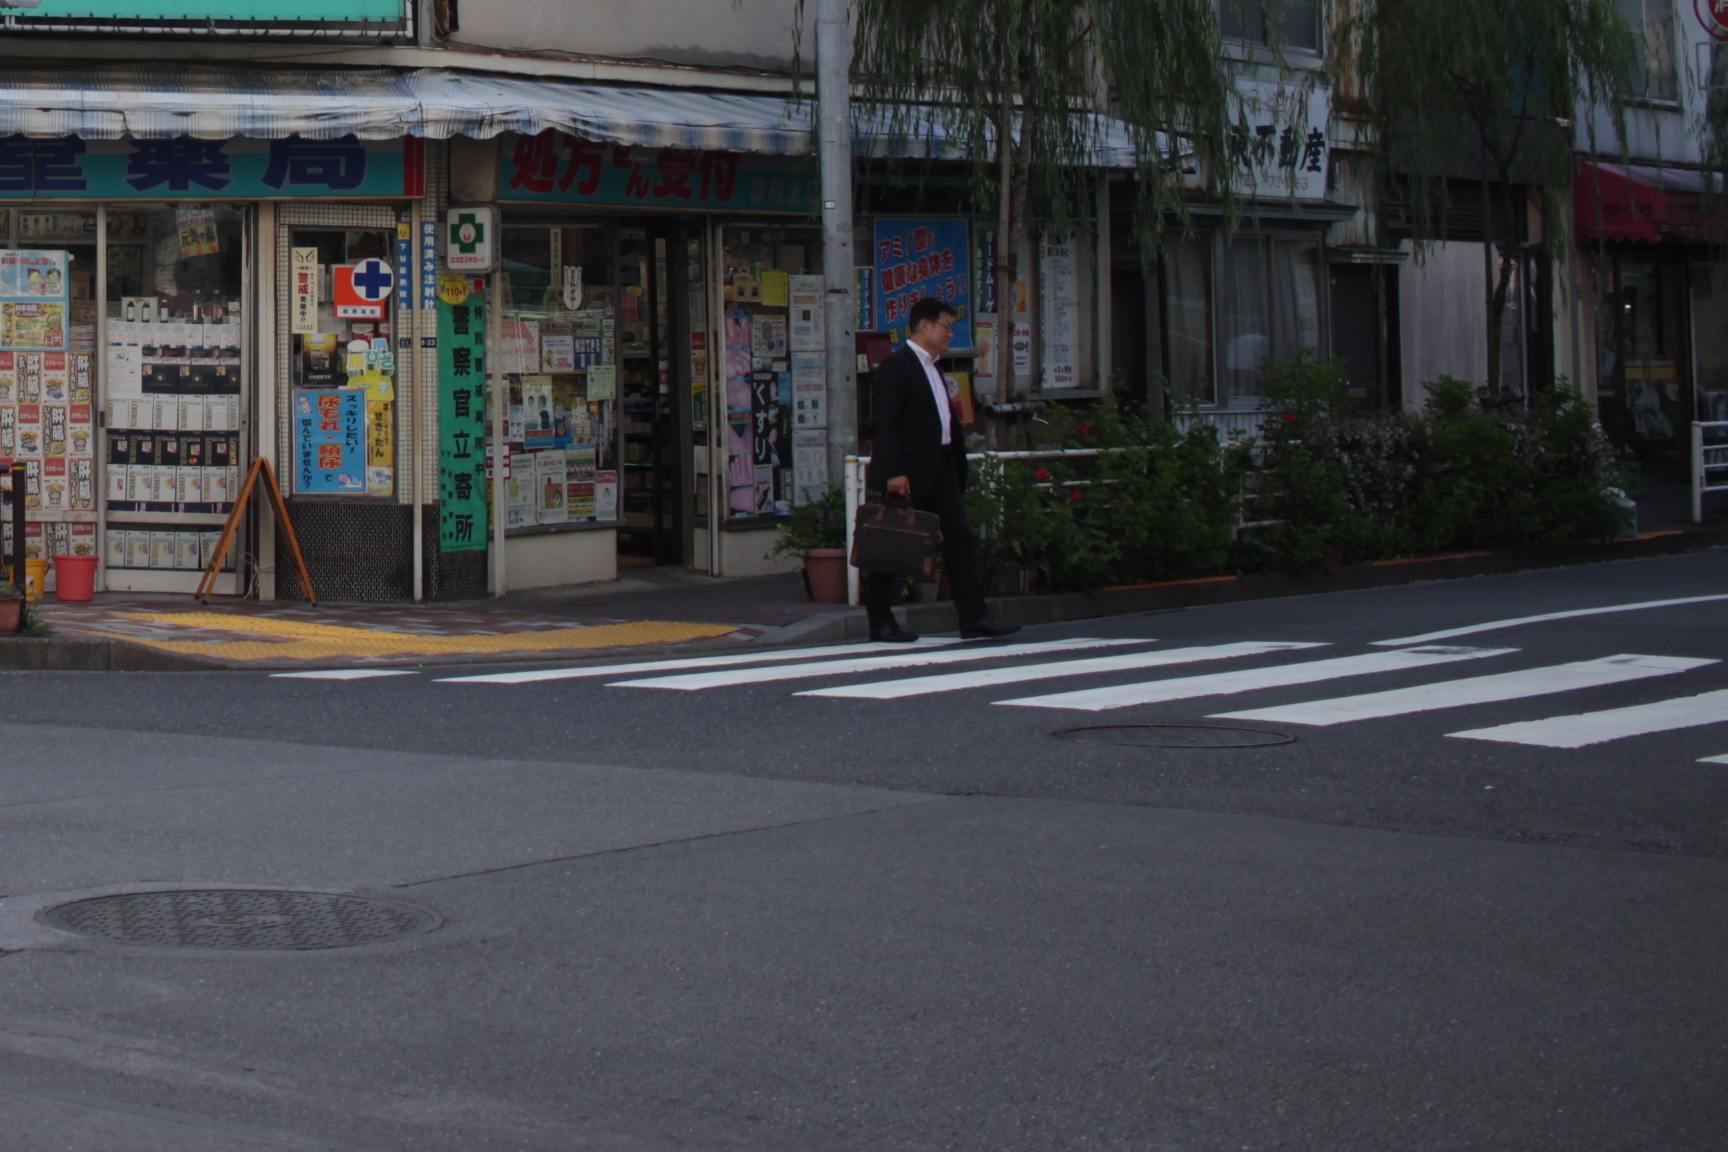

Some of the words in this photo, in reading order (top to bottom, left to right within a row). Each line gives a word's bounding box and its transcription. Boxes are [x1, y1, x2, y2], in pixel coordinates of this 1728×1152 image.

[180, 225, 217, 247] 元気の素
[881, 248, 954, 295] 健康な身体を
[452, 304, 474, 543] 警察官立寄所
[473, 305, 485, 477] 特別警戒実施中
[754, 381, 767, 461] くすり
